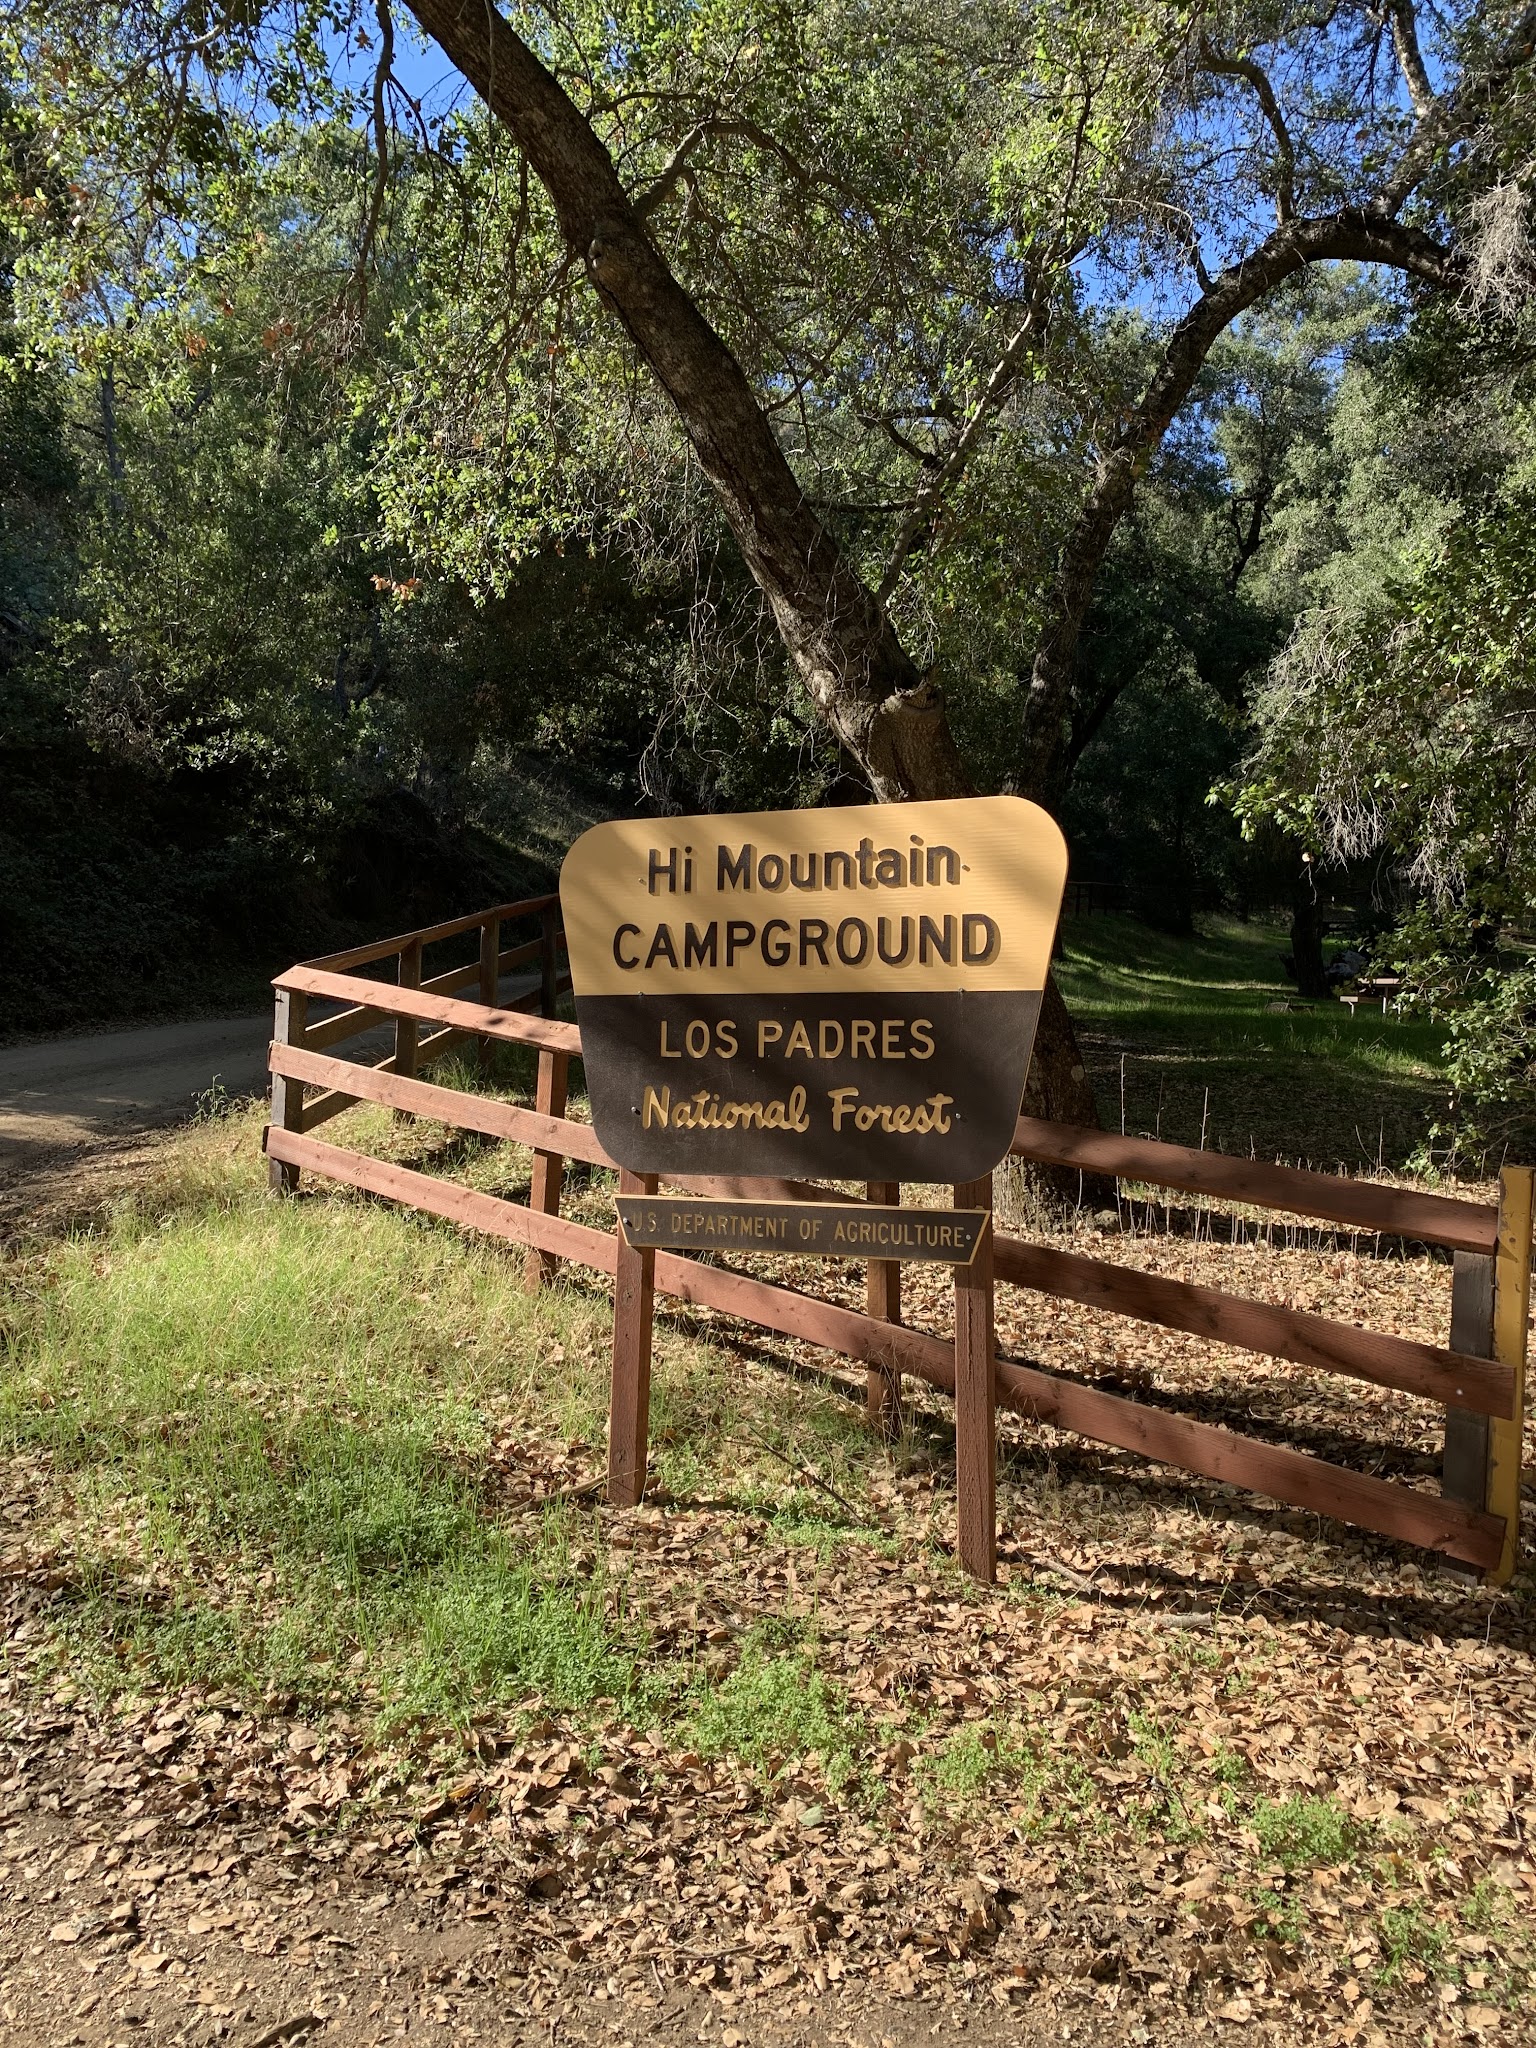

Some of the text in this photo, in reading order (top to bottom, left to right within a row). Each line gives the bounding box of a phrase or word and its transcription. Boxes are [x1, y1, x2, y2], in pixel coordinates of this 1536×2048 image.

[647, 834, 962, 896] Hi Mountain
[612, 913, 1001, 970] CAMPGROUND
[659, 1019, 936, 1061] LOS PADRES
[642, 1085, 955, 1135] National Forest
[670, 1213, 788, 1239] DEPARTMENT
[799, 1218, 824, 1239] OF
[835, 1221, 965, 1248] AGRICULTURE
